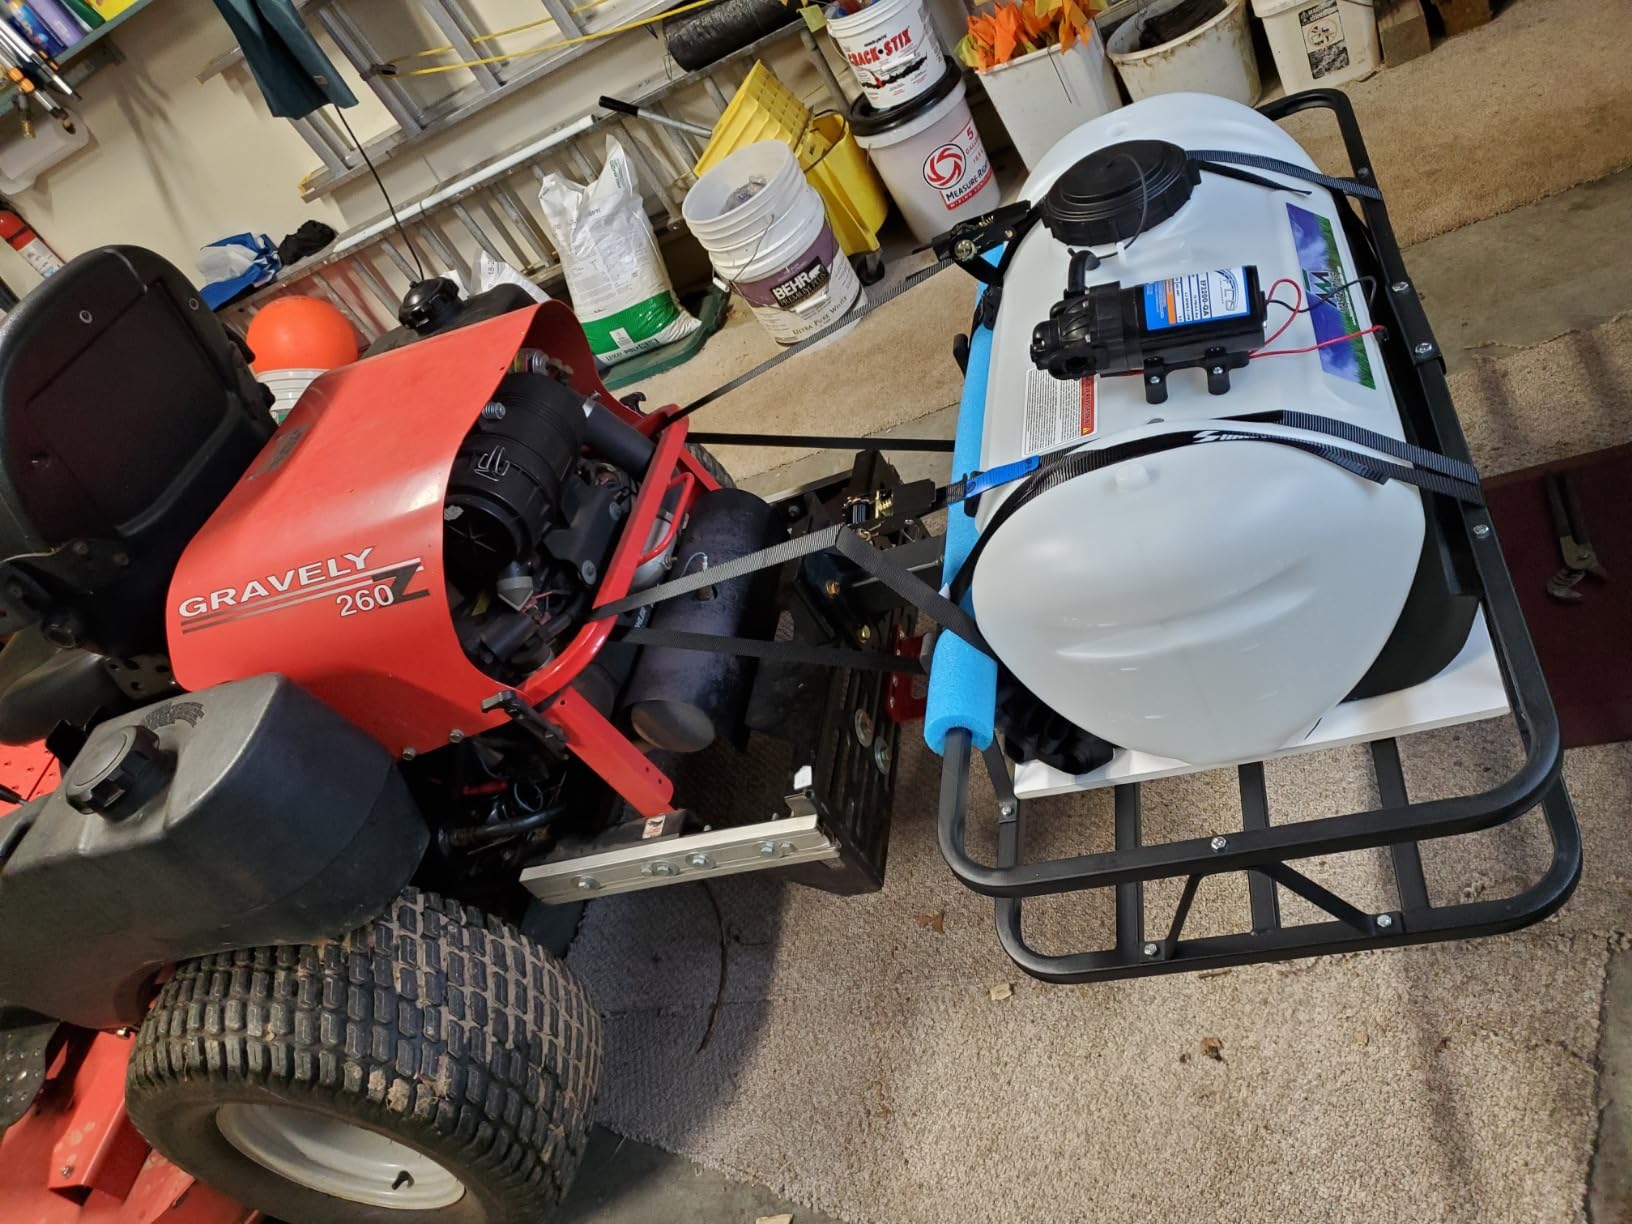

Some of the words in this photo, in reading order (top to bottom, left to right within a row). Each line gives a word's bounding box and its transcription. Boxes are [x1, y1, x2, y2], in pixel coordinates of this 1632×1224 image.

[967, 126, 974, 140] 5
[772, 272, 810, 300] BEHR
[1200, 279, 1210, 317] EF2200-QA
[178, 547, 375, 618] GRAVELY
